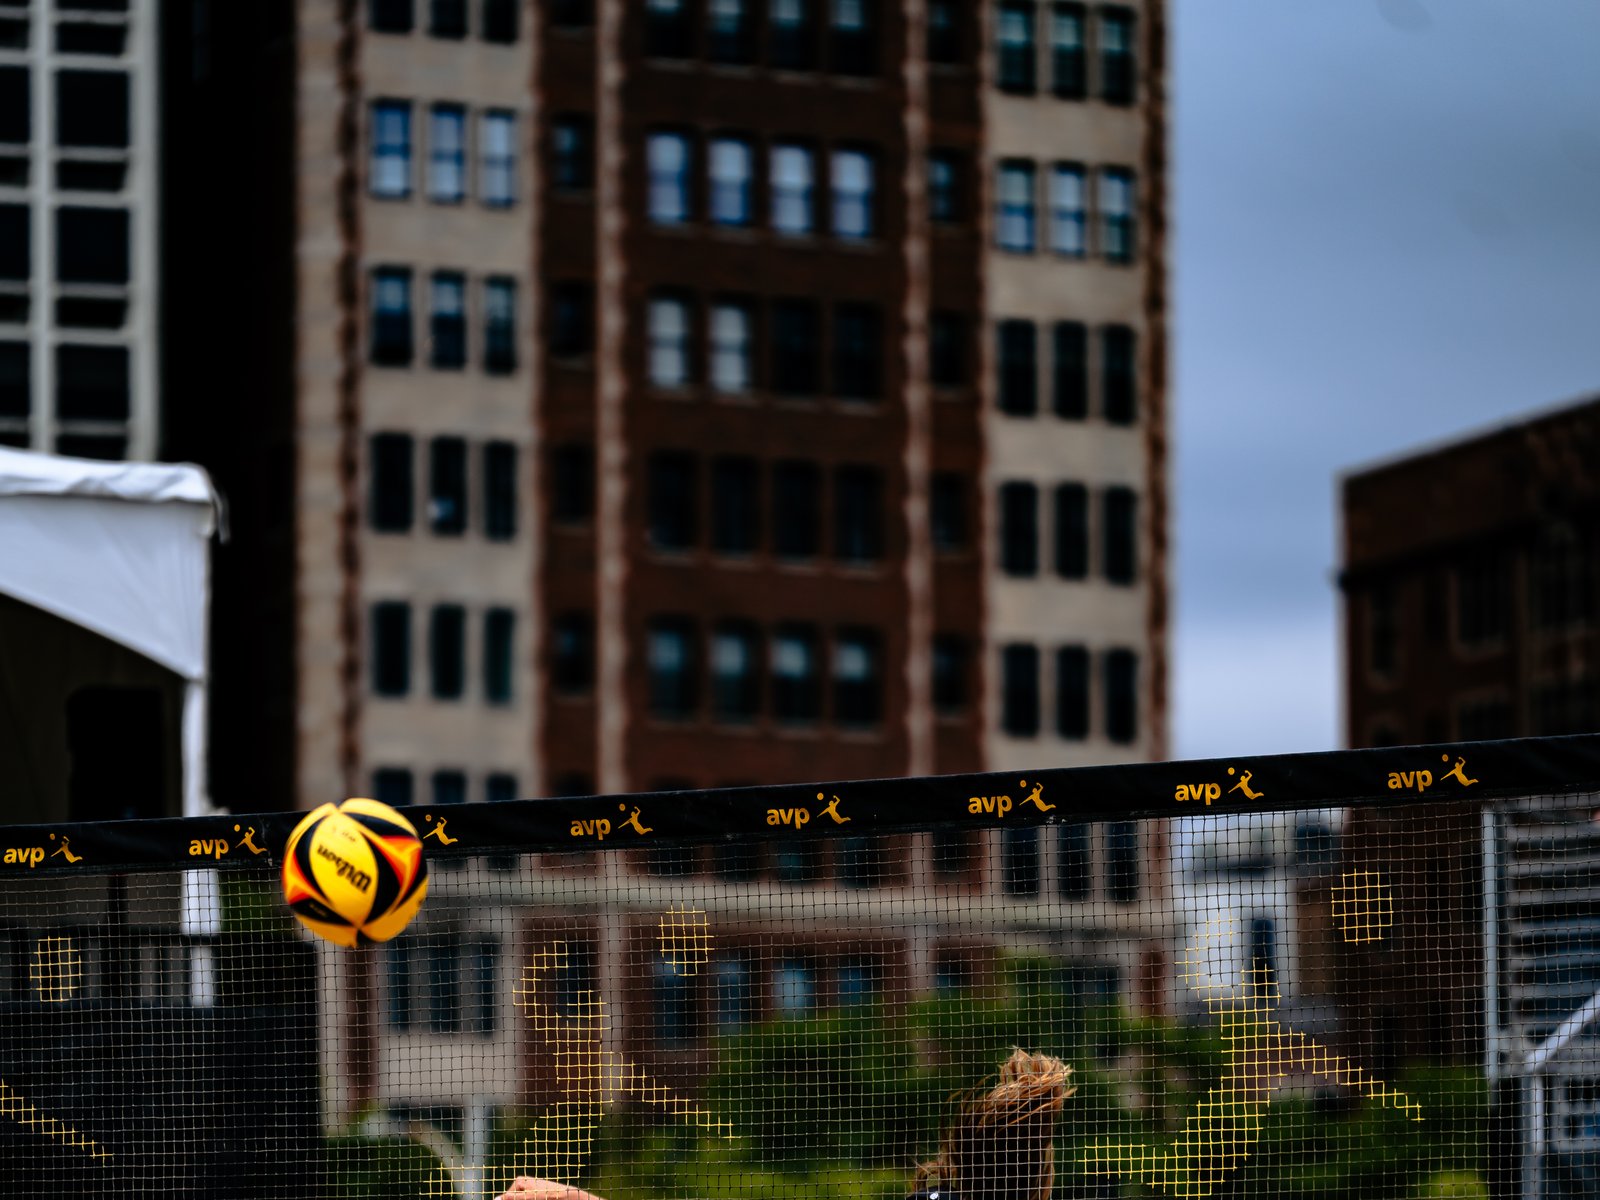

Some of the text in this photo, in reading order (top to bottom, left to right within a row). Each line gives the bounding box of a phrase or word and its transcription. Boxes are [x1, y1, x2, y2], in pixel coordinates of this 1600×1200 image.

[1388, 769, 1432, 792] avp
[1175, 783, 1220, 806] avp
[767, 807, 809, 829] avp
[969, 796, 1012, 818] avp
[571, 818, 610, 841] avp
[4, 846, 44, 868] avp
[189, 839, 229, 860] avp
[316, 844, 372, 893] Wilson
